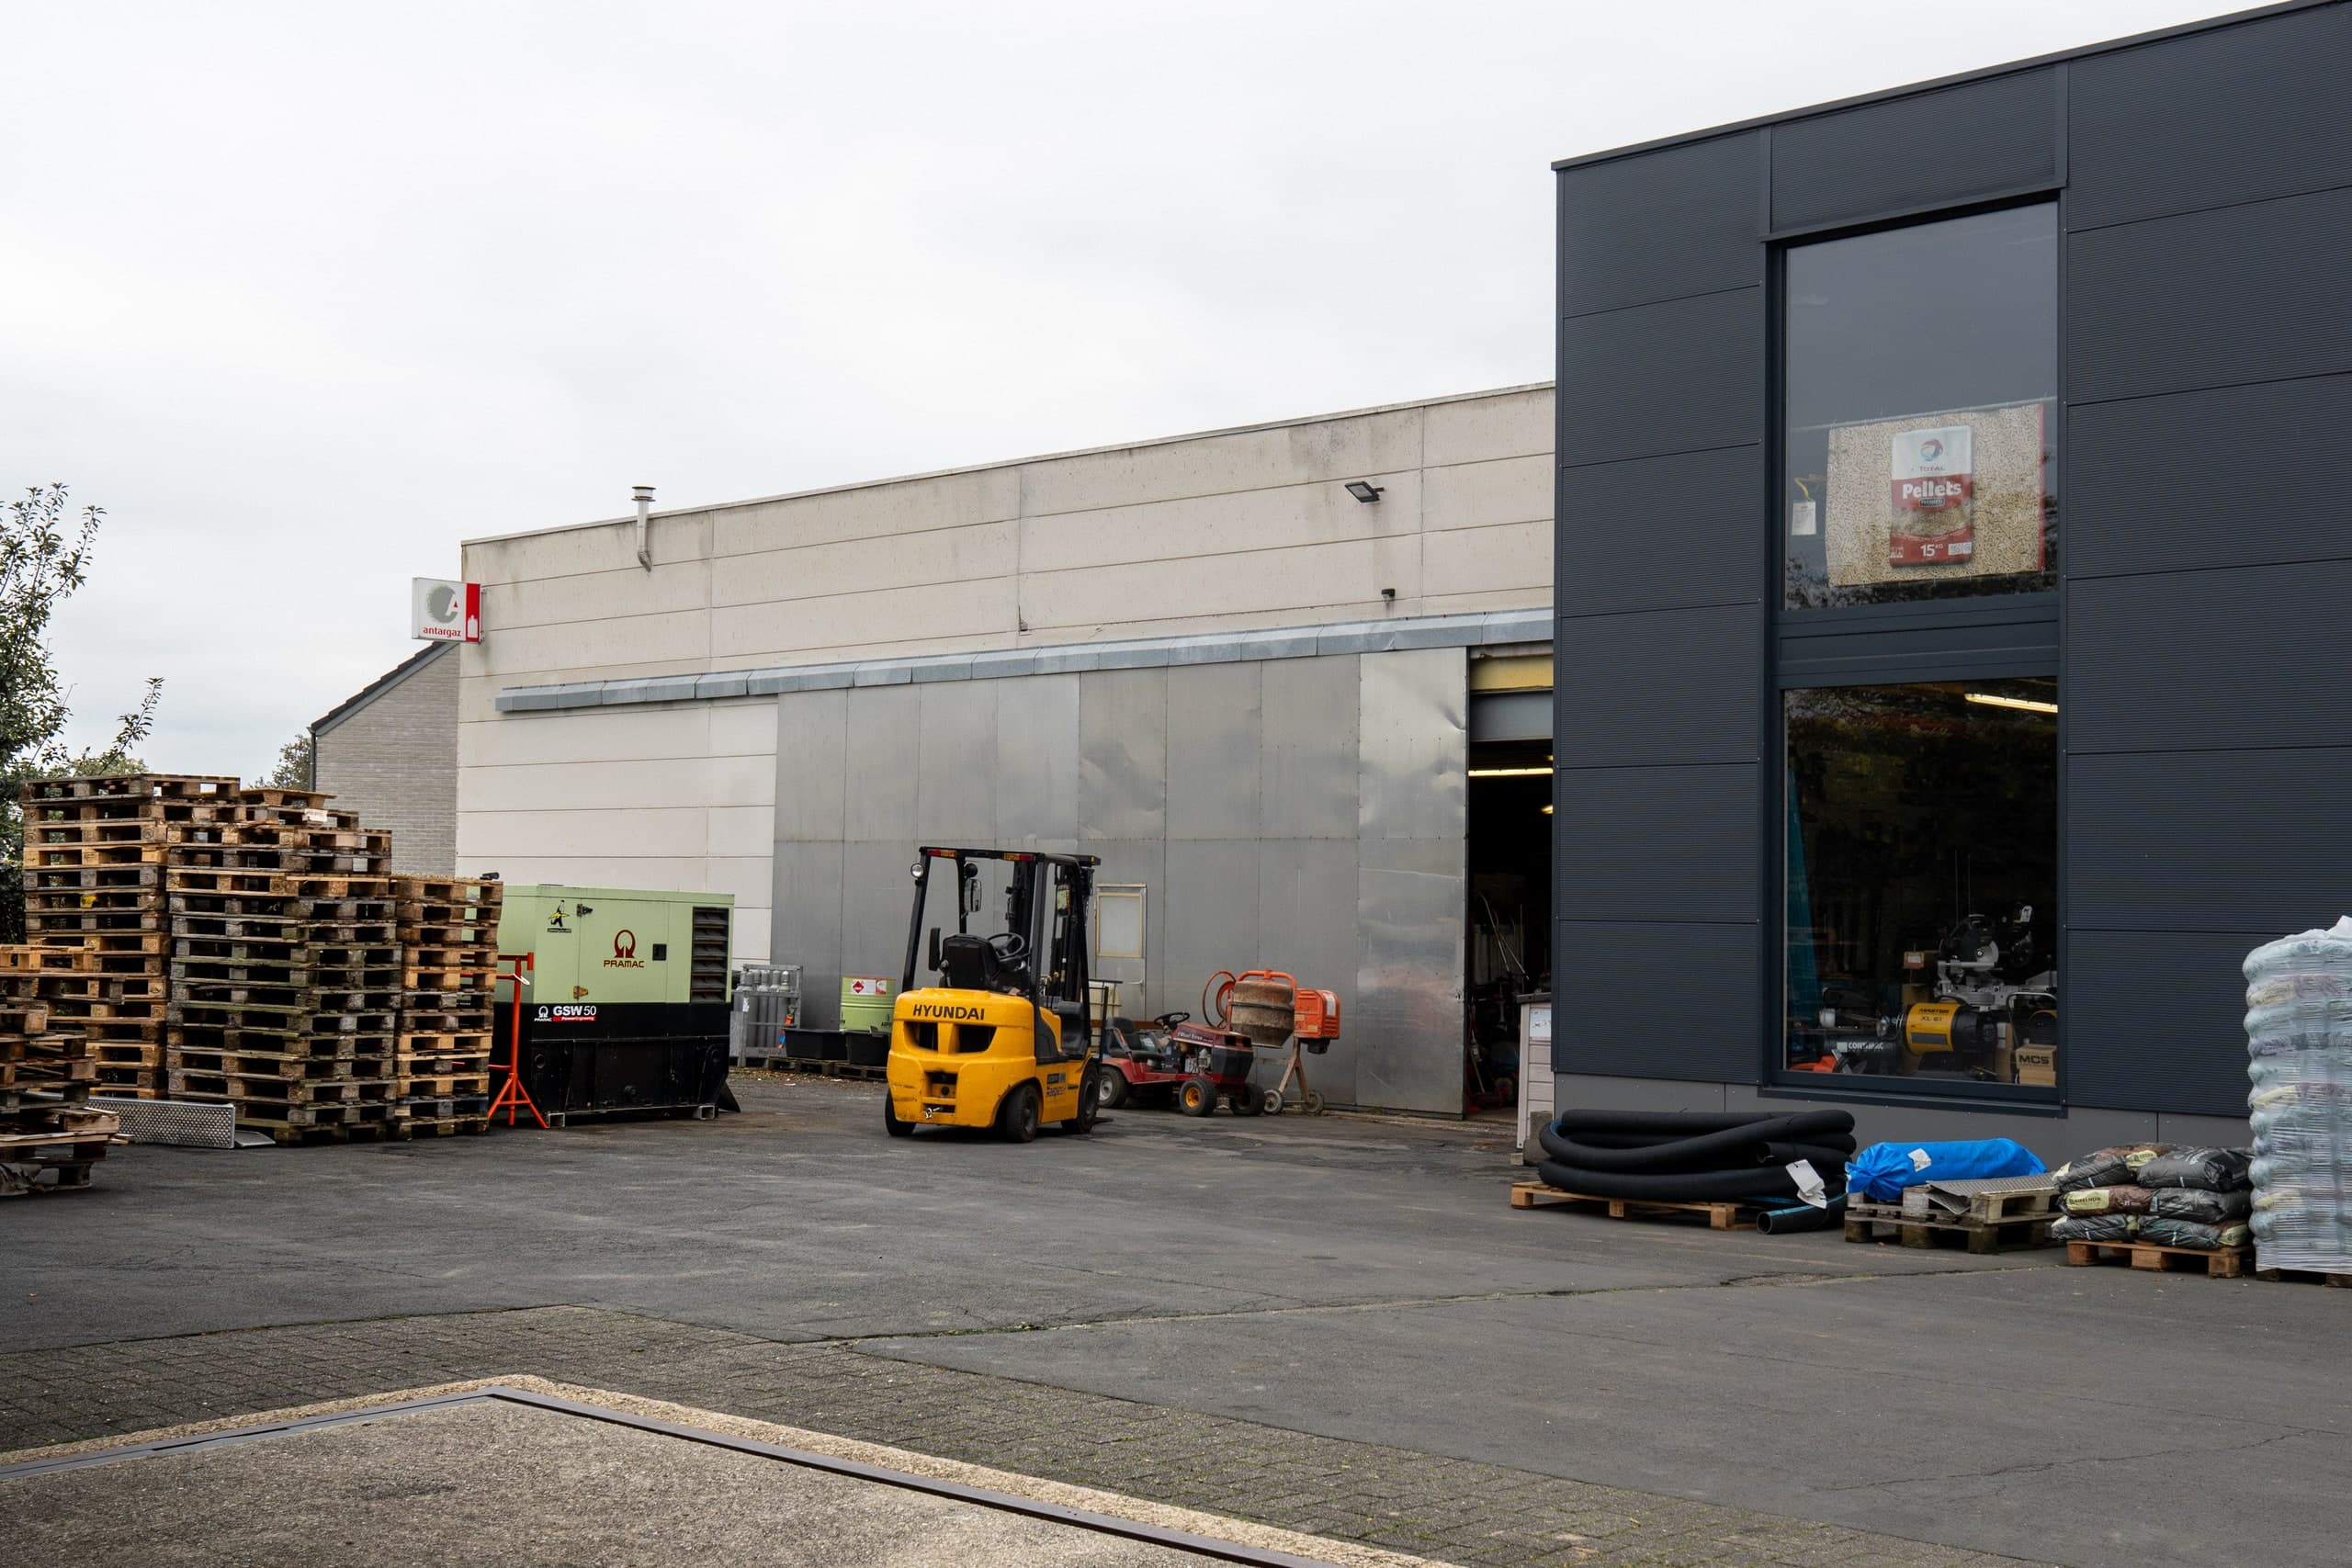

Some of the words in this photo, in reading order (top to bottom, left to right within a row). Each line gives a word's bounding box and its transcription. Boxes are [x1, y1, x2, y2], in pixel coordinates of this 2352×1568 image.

[1902, 480, 1962, 501] Pellets
[1920, 544, 1935, 558] 15
[423, 626, 461, 638] antargaz
[603, 960, 645, 968] PRAMAC
[912, 1004, 985, 1021] HYUNDAI
[2018, 1055, 2051, 1065] MCS
